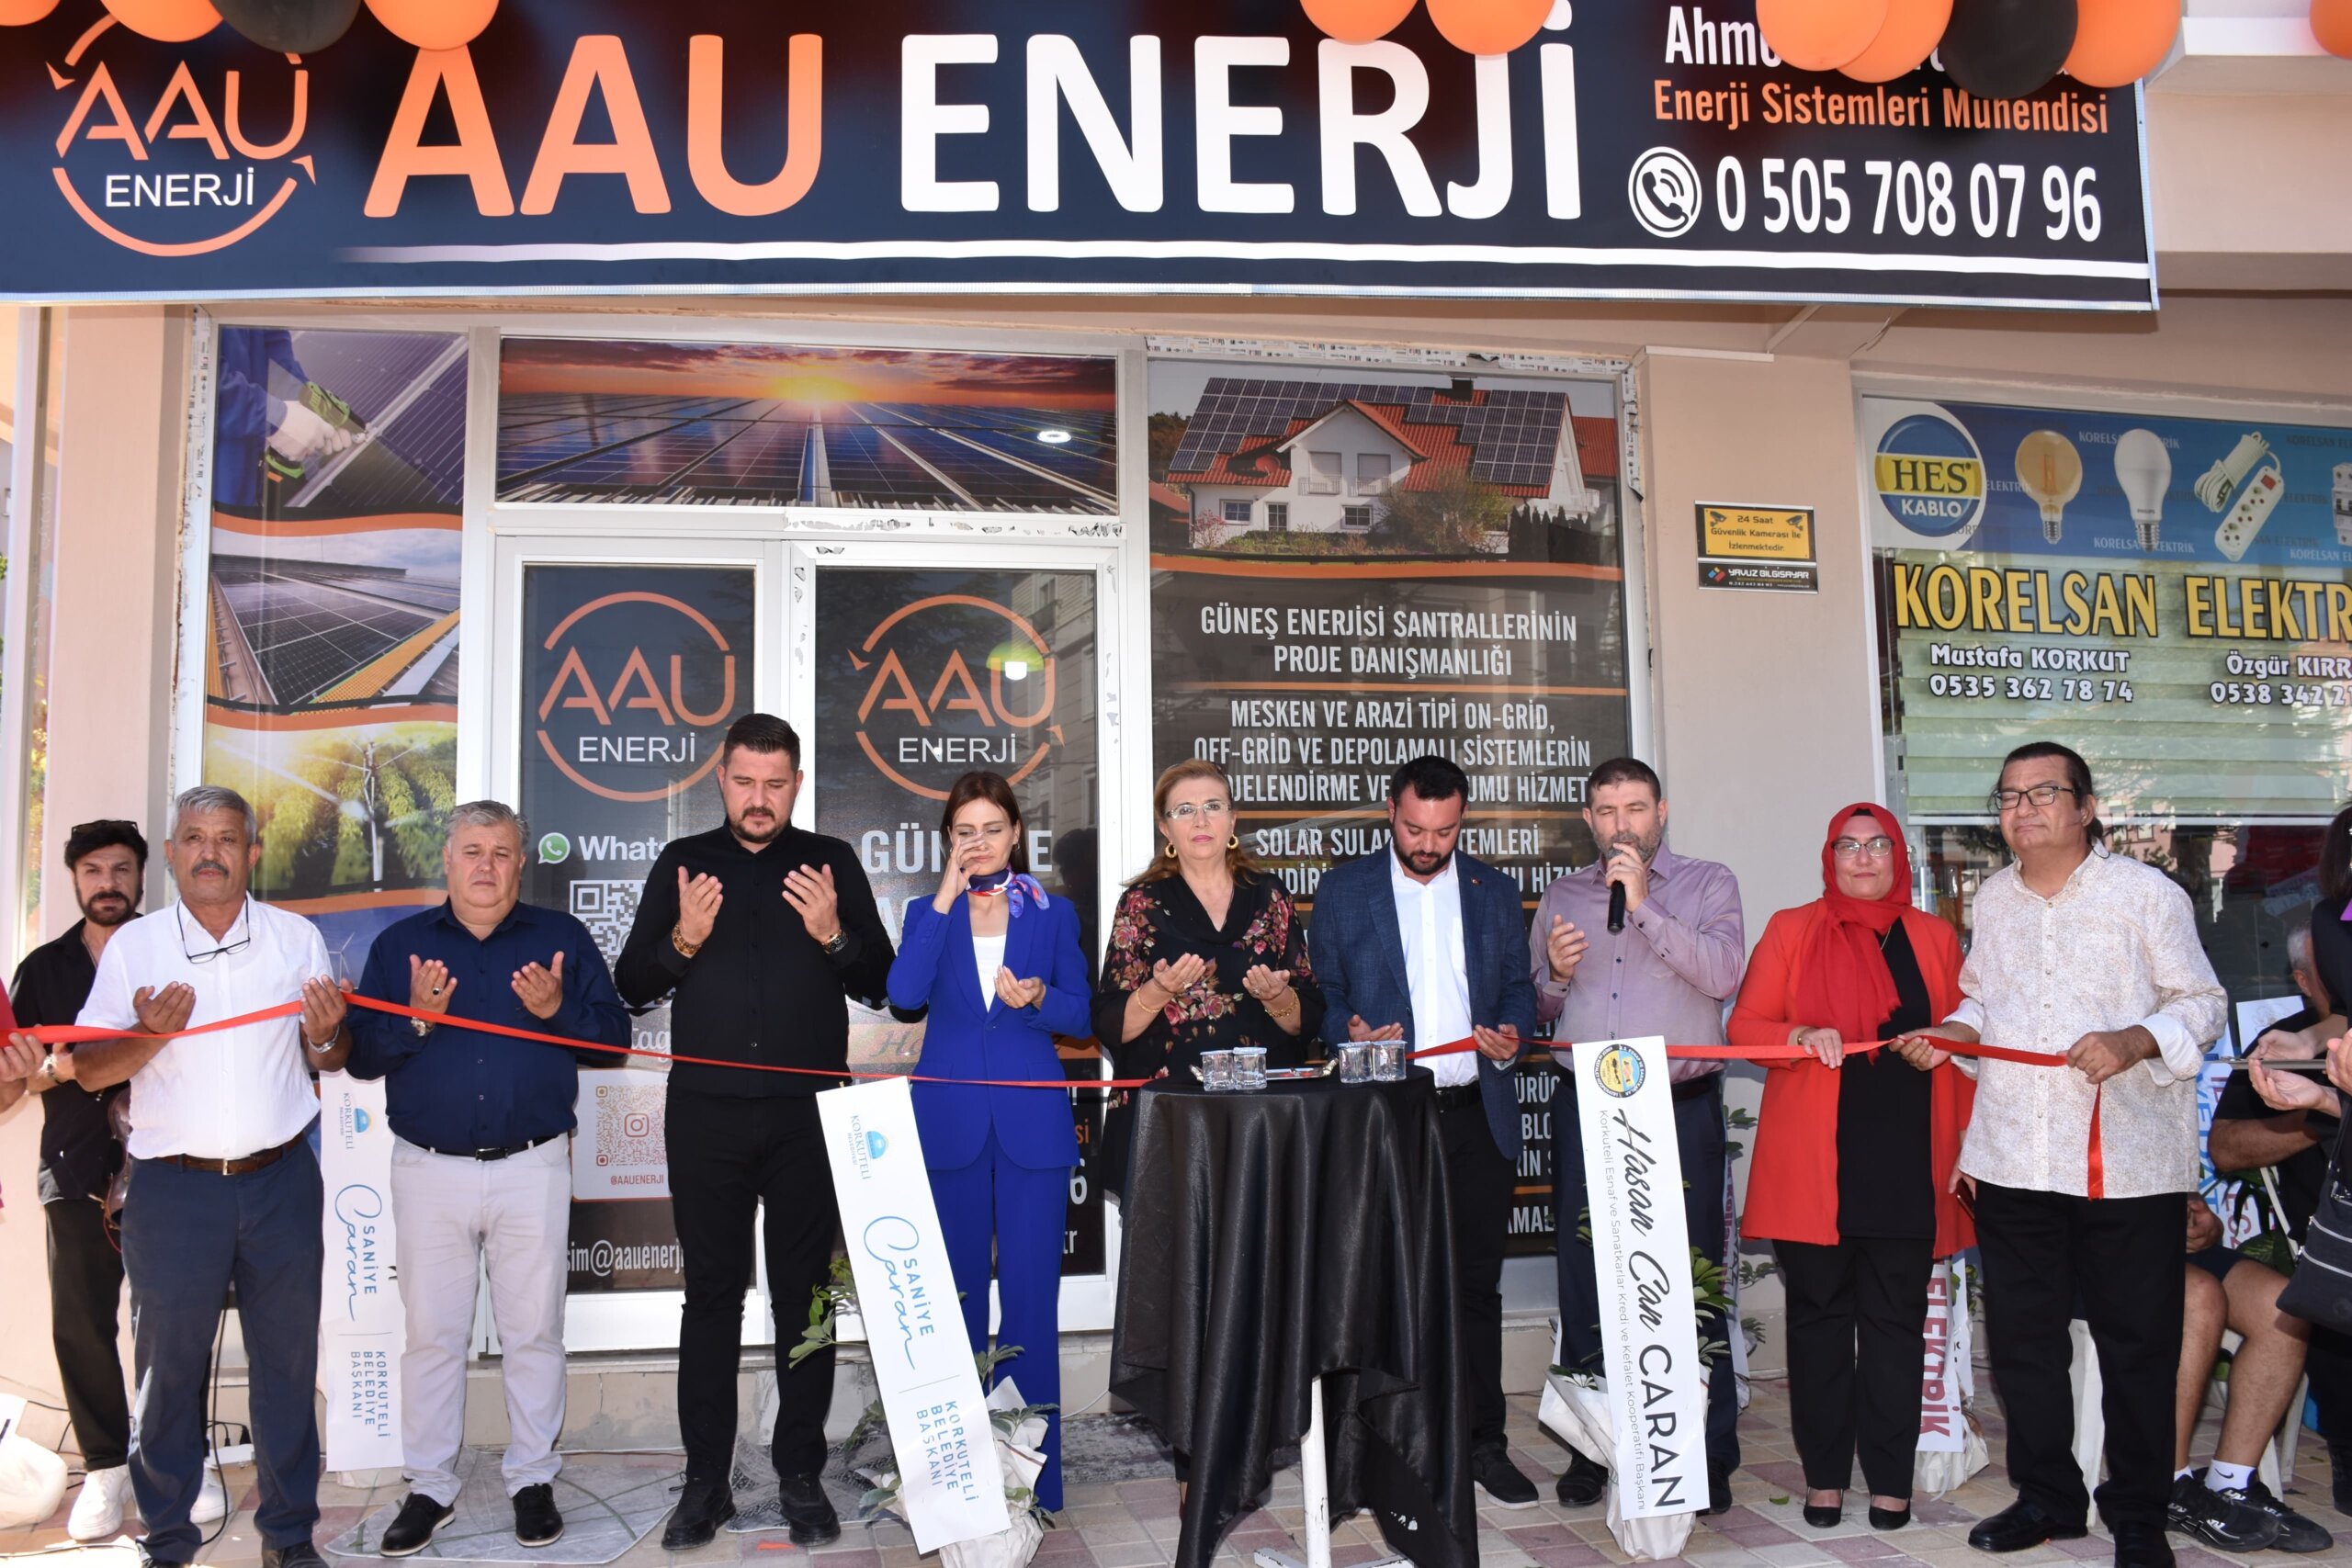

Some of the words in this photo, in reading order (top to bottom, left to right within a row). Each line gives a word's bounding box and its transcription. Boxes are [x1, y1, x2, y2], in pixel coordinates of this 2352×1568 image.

[56, 61, 308, 160] AAU
[364, 34, 822, 218] AAU
[901, 0, 1581, 220] ENERJİ
[1655, 80, 1749, 130] Enerji
[1761, 83, 1929, 128] Sistemleri
[105, 167, 254, 208] ENERJİ
[1716, 156, 1746, 232] 0
[1762, 158, 1850, 234] 505
[1865, 160, 1956, 237] 708
[1970, 163, 2025, 239] 07
[2042, 165, 2102, 242] 96
[1893, 459, 1968, 495] HES
[1753, 515, 1773, 525] Saat
[1902, 499, 1962, 518] KABLO
[1711, 527, 1747, 536] Güvenlik
[1893, 563, 2159, 638] KORELSAN
[1201, 603, 1278, 640] GÜNEŞ
[1287, 605, 1385, 637] ENERJİSİ
[1394, 610, 1577, 641] SANTRALLERİNİN
[1274, 645, 1341, 672] PROJE
[1351, 645, 1512, 679] DANIŞMANLIĞI
[1930, 643, 2023, 669] Mustafa
[2030, 647, 2132, 673] KORKUT
[2226, 649, 2290, 680] Özgür
[538, 646, 735, 727] AAU
[857, 648, 1056, 728] AAU
[1929, 673, 1996, 698] 0535
[2006, 676, 2052, 700] 362
[2063, 679, 2094, 702] 78
[2103, 680, 2134, 703] 74
[2210, 681, 2272, 704] 0538
[2279, 683, 2324, 705] 342
[1231, 700, 1316, 728] MESKEN
[1323, 701, 1348, 728] VE
[1355, 697, 1412, 728] ARAZİ
[1419, 697, 1457, 728] TİPİ
[1464, 700, 1555, 734] ON-GRİD,
[579, 732, 695, 762] ENERJİ
[899, 733, 1016, 763] ENERJİ
[1194, 733, 1290, 764] OFF-GRİD
[1298, 738, 1323, 764] VE
[1464, 735, 1590, 766] SİSTEMLERİN
[1367, 774, 1391, 801] VE
[1256, 829, 1323, 856] SOLAR
[1599, 1110, 1611, 1164] Korkuteli
[1605, 1167, 1617, 1203] Esnaf
[1612, 1109, 1657, 1237] Hasan
[1610, 1202, 1617, 1218] ve
[363, 1225, 379, 1294] SANİYE
[1611, 1220, 1626, 1291] Sanatkarlar
[903, 1258, 934, 1337] SANİYE
[1618, 1292, 1628, 1325] Kredi
[1629, 1250, 1670, 1333] Can
[1621, 1327, 1629, 1342] ve
[351, 1351, 362, 1418] BAŞKANI
[1623, 1345, 1634, 1388] Kefalet
[363, 1351, 378, 1426] BELEDİYE
[376, 1351, 390, 1438] KORKUTELİ
[1628, 1391, 1644, 1461] Kooperatifi
[1639, 1344, 1686, 1507] CARAN
[931, 1404, 959, 1490] BELEDİYE
[945, 1401, 979, 1501] KORKUTELİ
